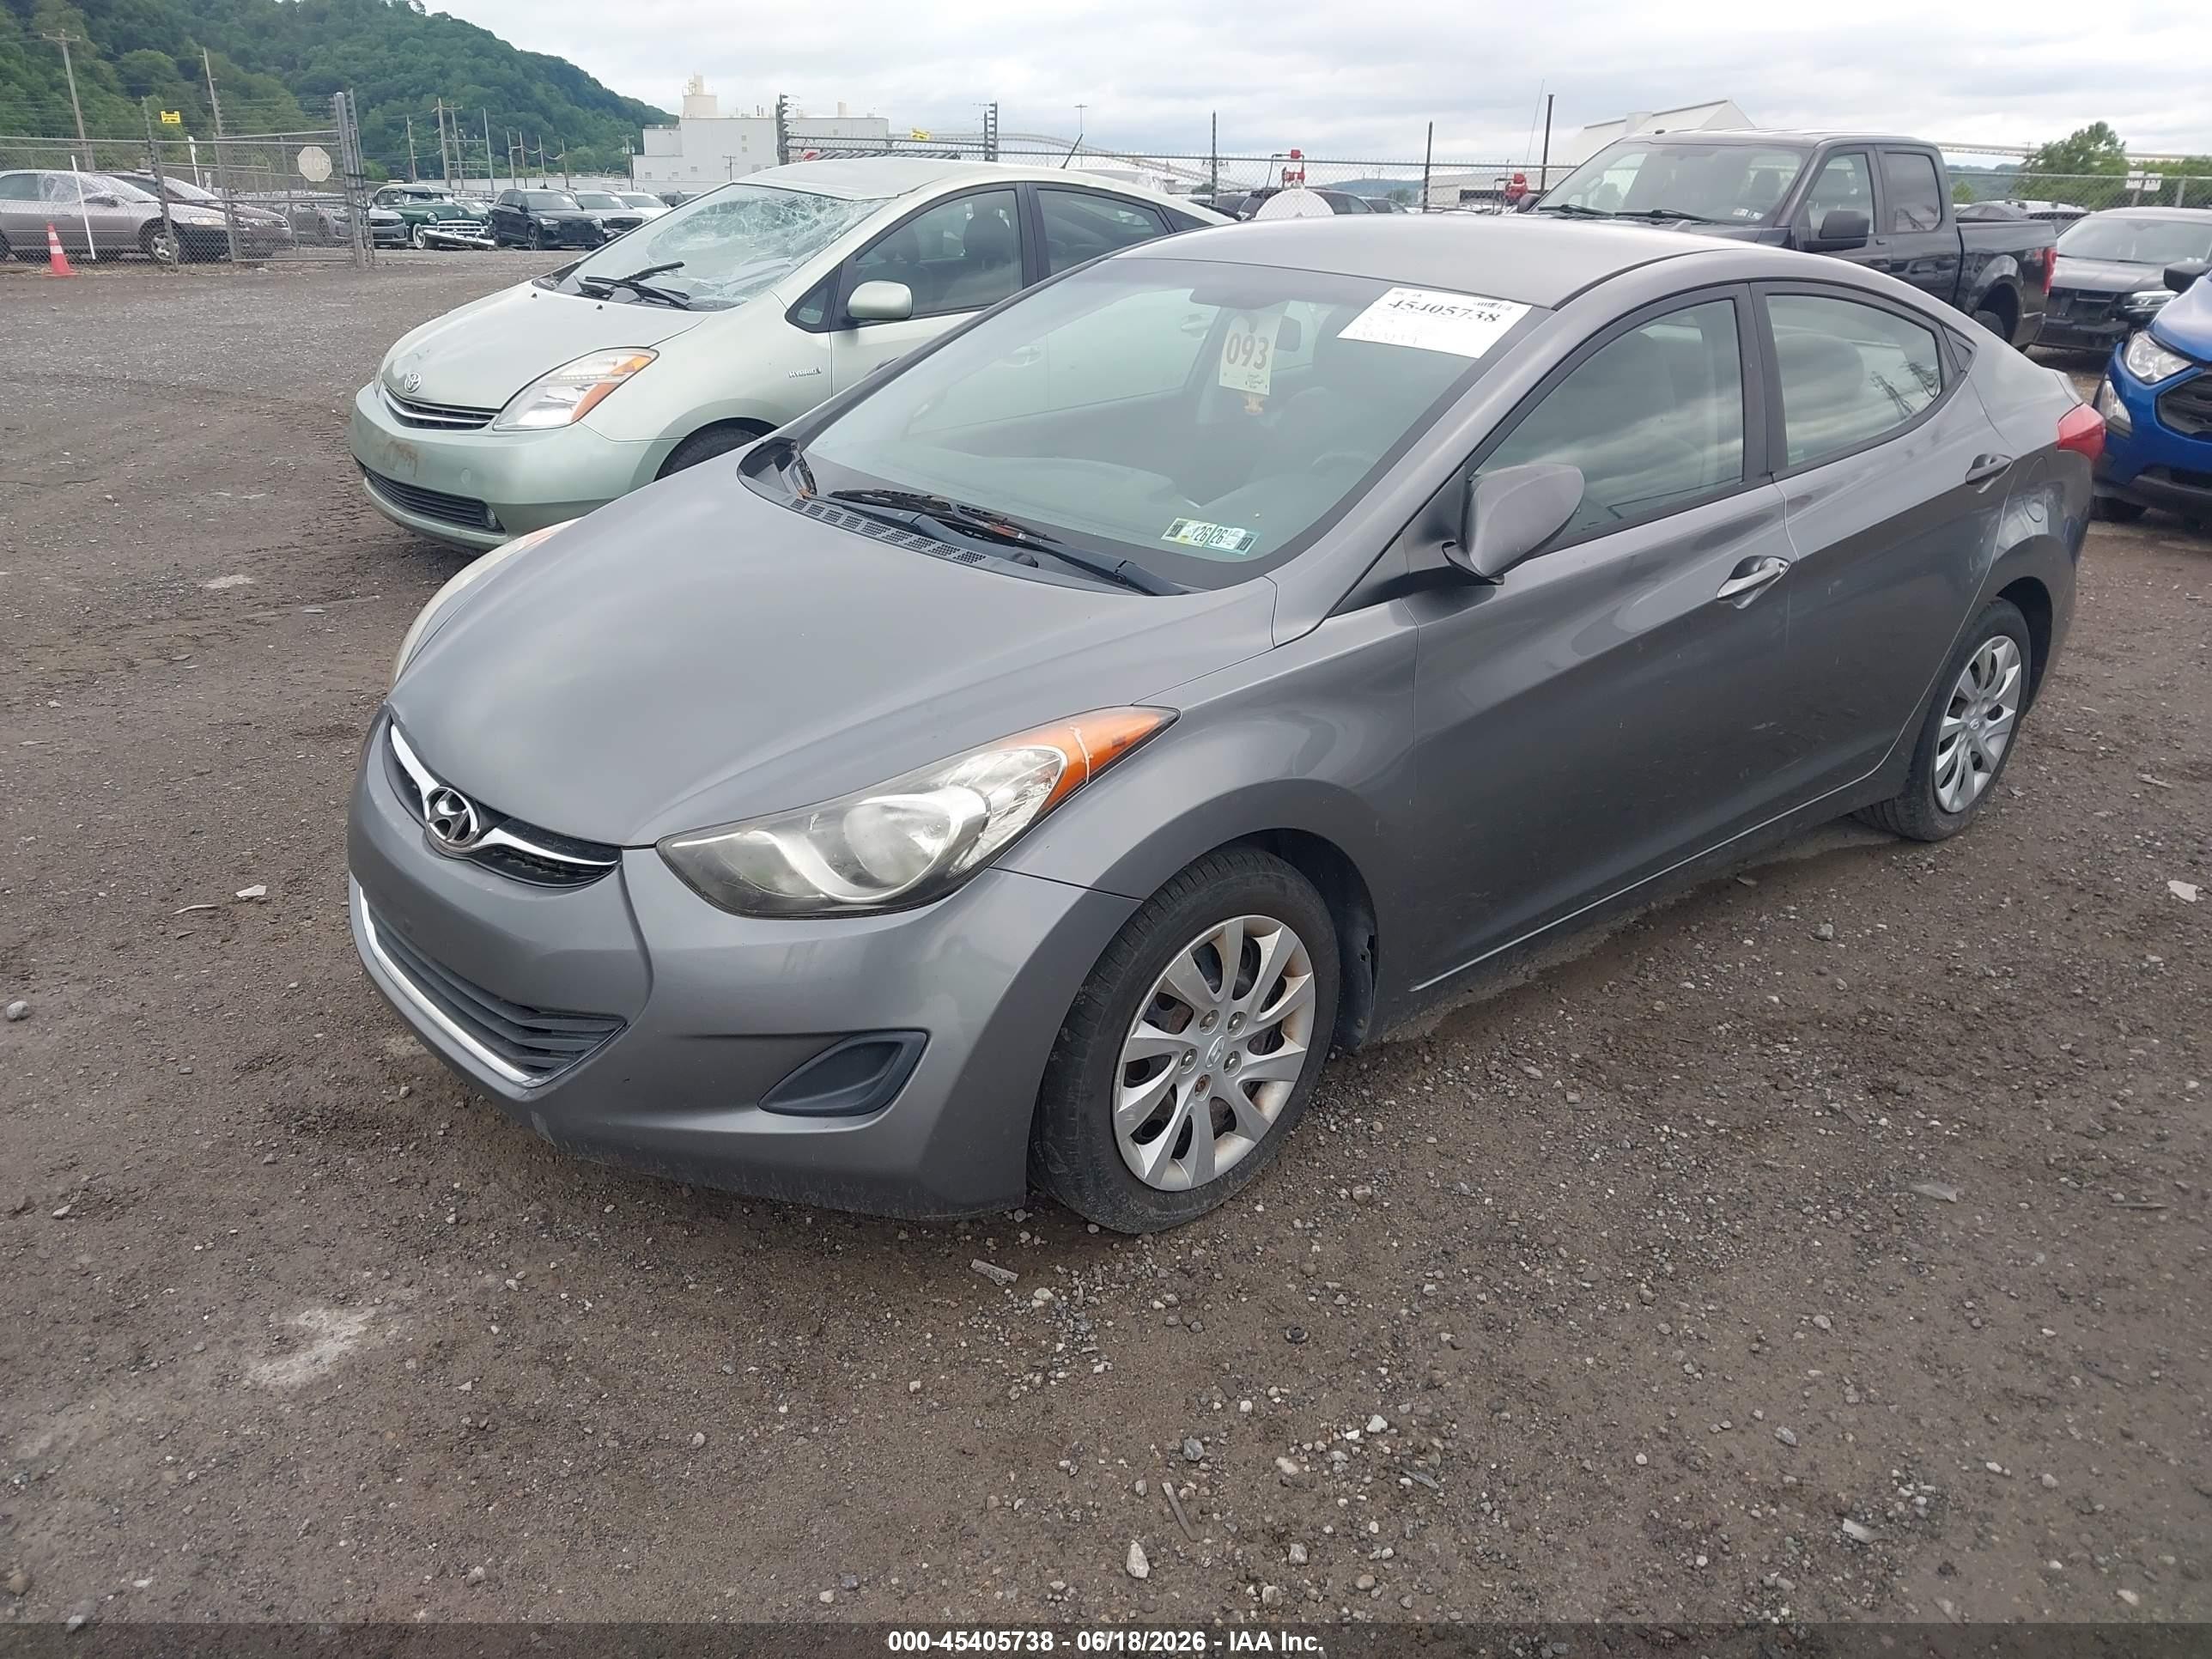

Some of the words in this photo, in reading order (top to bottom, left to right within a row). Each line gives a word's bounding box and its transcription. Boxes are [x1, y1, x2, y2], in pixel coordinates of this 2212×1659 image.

[301, 157, 330, 172] STOP
[1388, 299, 1501, 323] 45405738
[1226, 332, 1269, 370] 093
[1194, 526, 1212, 542] 26
[1210, 528, 1229, 544] 26
